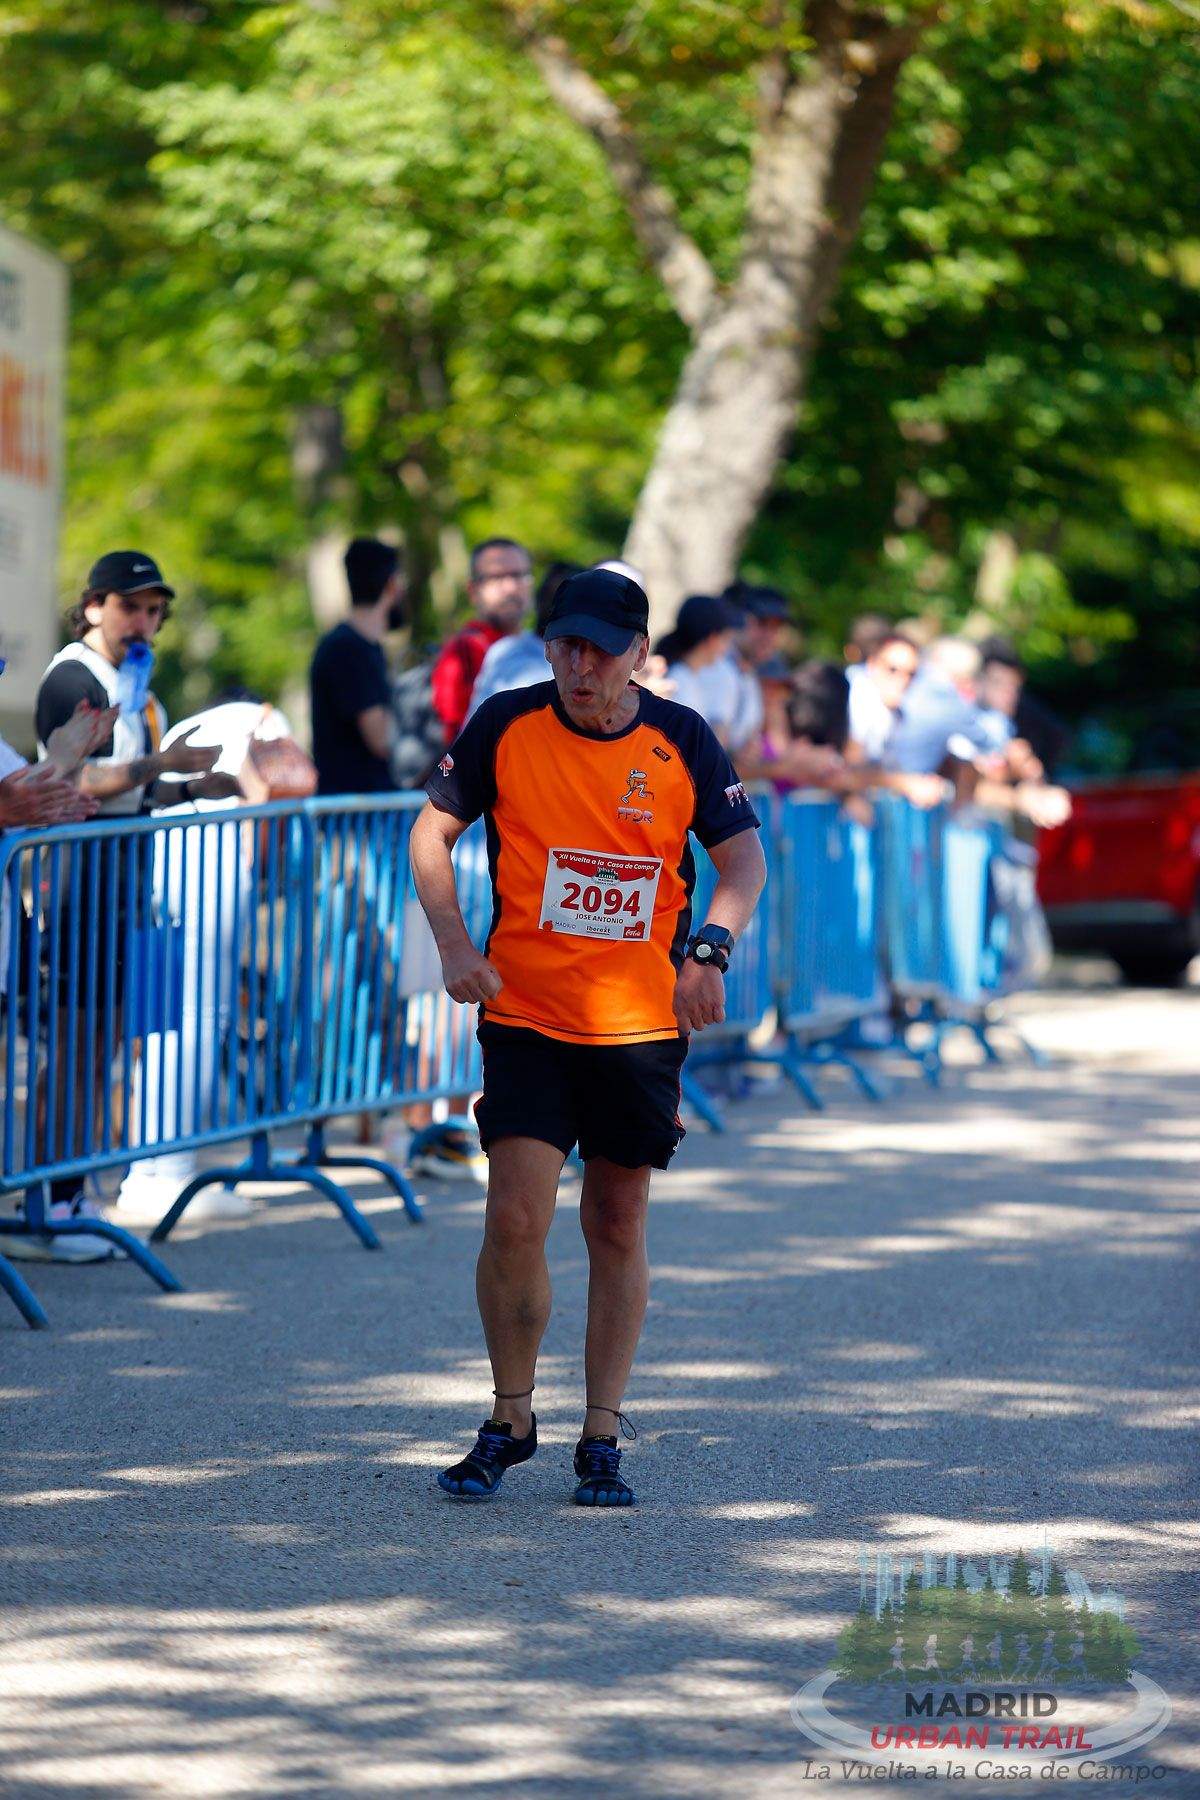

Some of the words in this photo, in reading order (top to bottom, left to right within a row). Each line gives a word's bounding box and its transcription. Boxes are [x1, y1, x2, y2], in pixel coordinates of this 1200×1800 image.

[569, 854, 591, 865] Vuelta
[607, 861, 624, 869] Casa
[560, 882, 641, 917] 2094
[593, 915, 624, 924] ANTONIO
